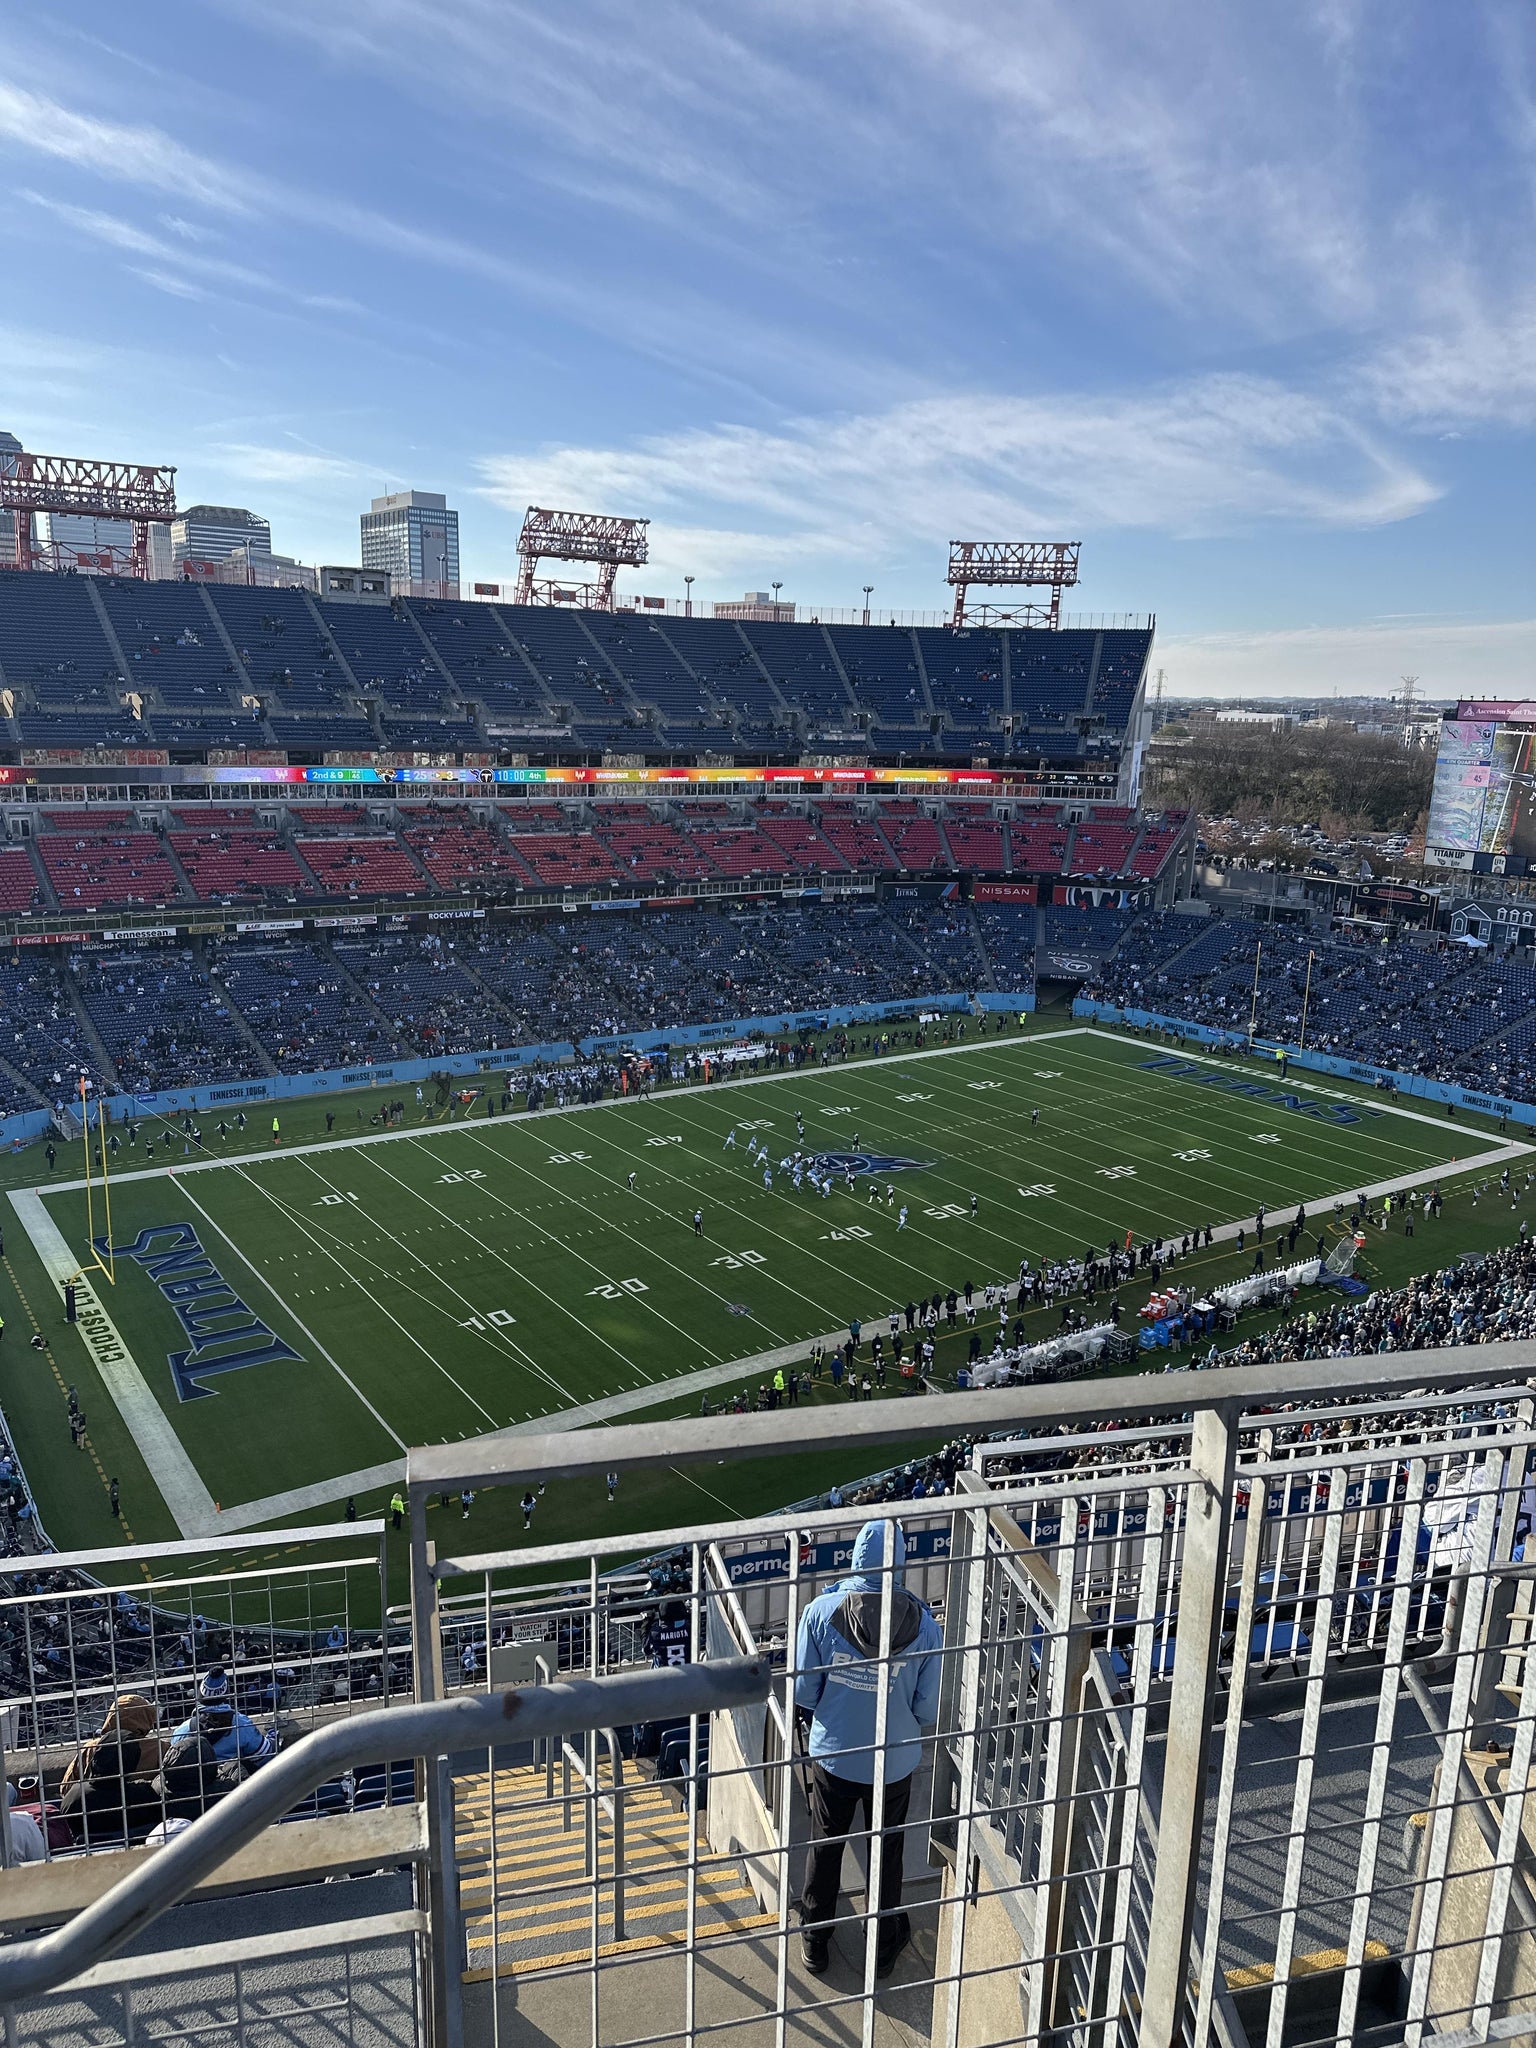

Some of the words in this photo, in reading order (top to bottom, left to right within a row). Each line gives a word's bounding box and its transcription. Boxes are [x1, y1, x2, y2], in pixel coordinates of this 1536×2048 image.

[1476, 708, 1506, 716] Ascension
[312, 771, 329, 779] 2nd
[330, 771, 336, 779] &
[337, 771, 344, 779] 9
[413, 771, 427, 781] 25
[446, 770, 454, 780] 3
[498, 770, 525, 781] 10:00
[528, 772, 541, 780] 4th
[1433, 849, 1454, 858] TITAN
[1454, 851, 1465, 859] UP
[895, 887, 918, 897] TITANS
[981, 887, 1030, 895] NISSAN
[428, 912, 453, 920] ROCKY
[455, 911, 471, 919] LAW
[1047, 951, 1099, 959] NISSAN
[1350, 1066, 1376, 1080] TENNESSEE
[966, 1080, 1000, 1090] 20
[1135, 1052, 1386, 1125] TITANS
[210, 1089, 244, 1101] TENNESSEE
[246, 1085, 267, 1097] TOUGH
[895, 1092, 930, 1103] 30
[1340, 1094, 1369, 1104] US
[1462, 1094, 1492, 1109] TENNESSEE
[1493, 1101, 1513, 1115] TOUGH
[819, 1106, 852, 1116] 40
[736, 1119, 775, 1130] 50
[647, 1135, 682, 1146] 40
[1248, 1133, 1282, 1145] 10
[549, 1150, 592, 1164] 30
[1171, 1149, 1213, 1162] 20
[440, 1169, 488, 1183] 20
[1095, 1165, 1138, 1179] 30
[1017, 1183, 1058, 1198] 40
[320, 1191, 359, 1206] 10
[922, 1203, 969, 1220] 50
[830, 1225, 873, 1241] 40
[714, 1250, 768, 1269] 30
[593, 1278, 650, 1299] 20
[84, 1221, 309, 1404] TITANS
[468, 1309, 517, 1331] 10
[76, 1308, 126, 1364] CHOOSE
[514, 1630, 531, 1639] YOUR
[532, 1628, 548, 1637] STEP
[519, 1623, 542, 1632] WATCH
[666, 1645, 686, 1667] 8
[766, 1650, 786, 1665] 14
[845, 1679, 875, 1691] SECURITY
